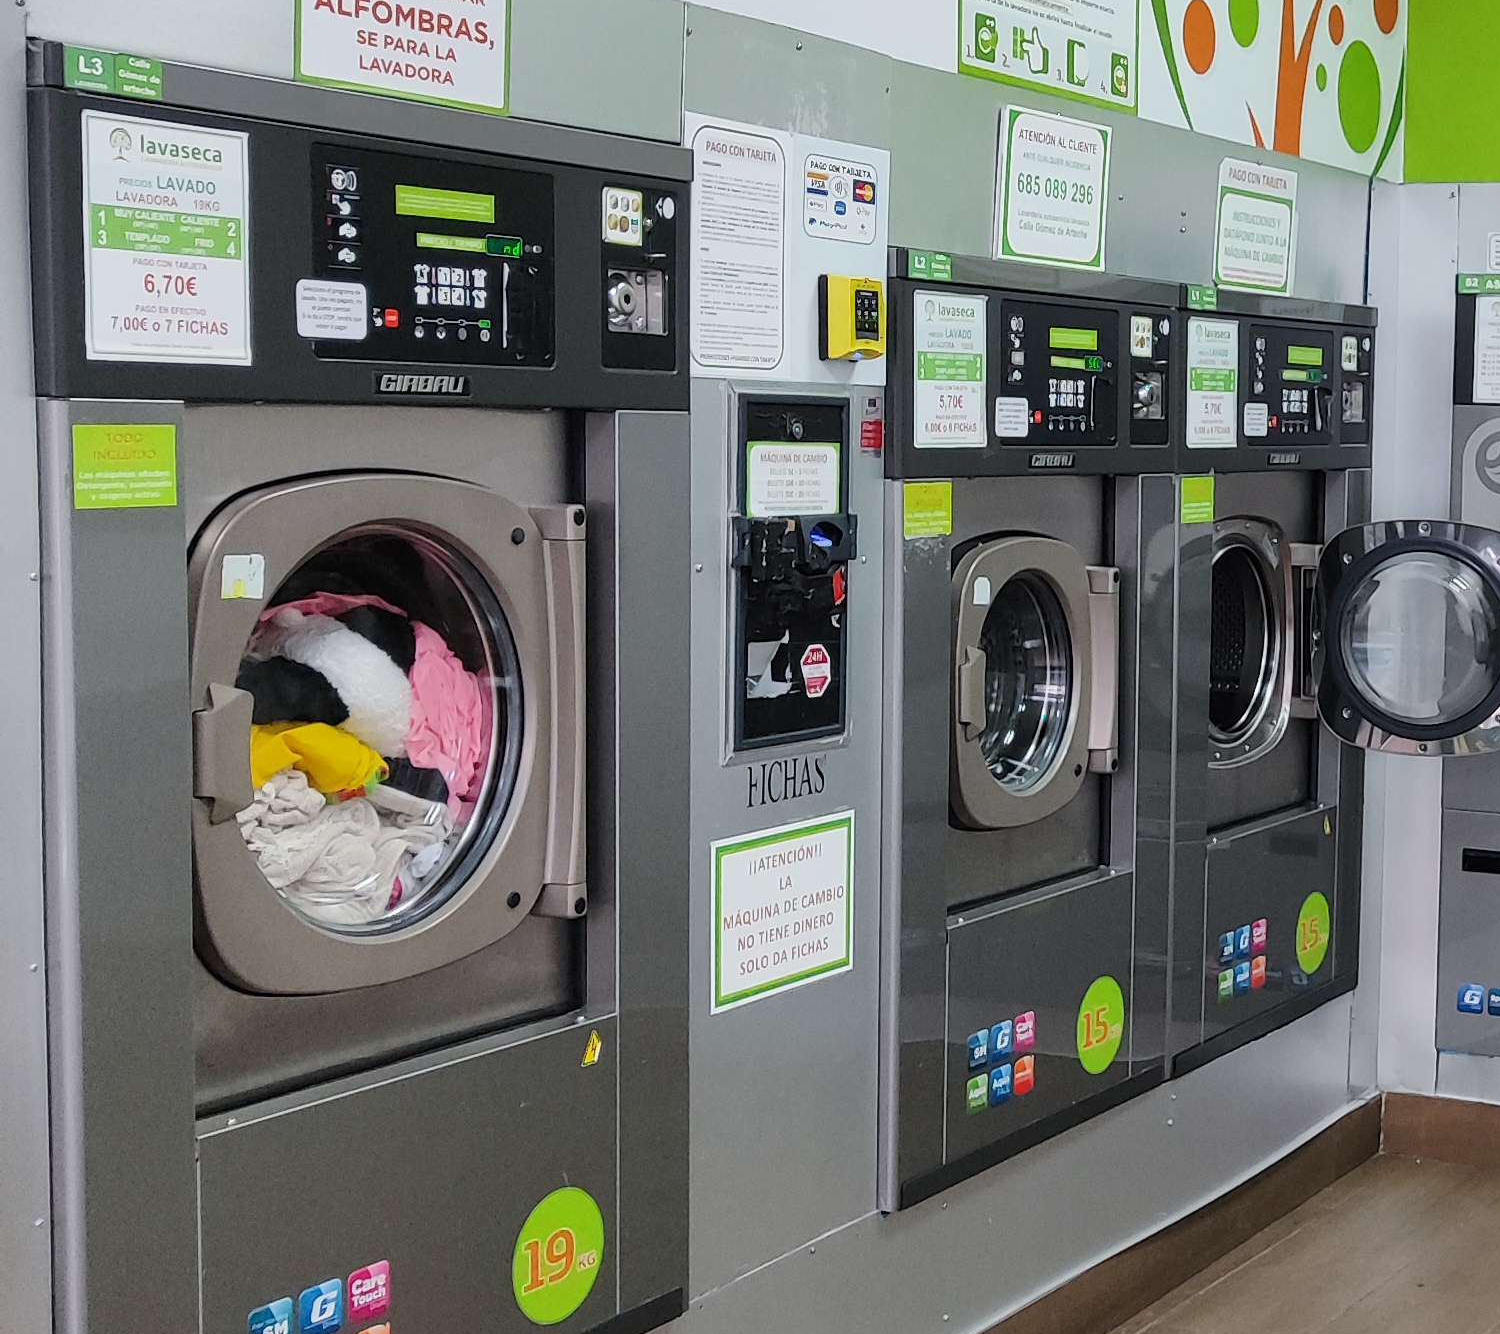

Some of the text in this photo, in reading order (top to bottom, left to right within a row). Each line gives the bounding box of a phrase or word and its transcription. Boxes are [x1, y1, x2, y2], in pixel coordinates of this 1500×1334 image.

[356, 29, 457, 62] SE PARA LA
[79, 55, 103, 76] L3
[359, 54, 454, 86] LAVADORA
[140, 134, 222, 163] lavaseca
[706, 140, 777, 163] PAGO CON TARJETA
[1018, 128, 1097, 155] ATENCIÓN AL CLIENTE
[116, 191, 178, 207] LAVADORA
[156, 176, 216, 195] LAVADO
[1018, 172, 1093, 205] 685 089 296
[144, 273, 198, 298] 6,70€
[938, 302, 975, 317] lavaseca
[111, 316, 148, 333] 7,00€
[165, 319, 173, 332] 7
[177, 319, 229, 336] FICHAS
[747, 755, 826, 807] FICHAS
[779, 875, 792, 891] LA
[723, 885, 844, 931] MÁQUINA DE CAMBIO
[738, 912, 834, 952] NO TIENE DINERO
[1300, 917, 1319, 951] 15
[740, 936, 829, 975] SOLO DA FICHAS
[1083, 1007, 1109, 1048] 15
[523, 1229, 597, 1294] 19 KG
[351, 1286, 386, 1308] Touch
[352, 1274, 386, 1295] Care
[311, 1290, 338, 1323] G
